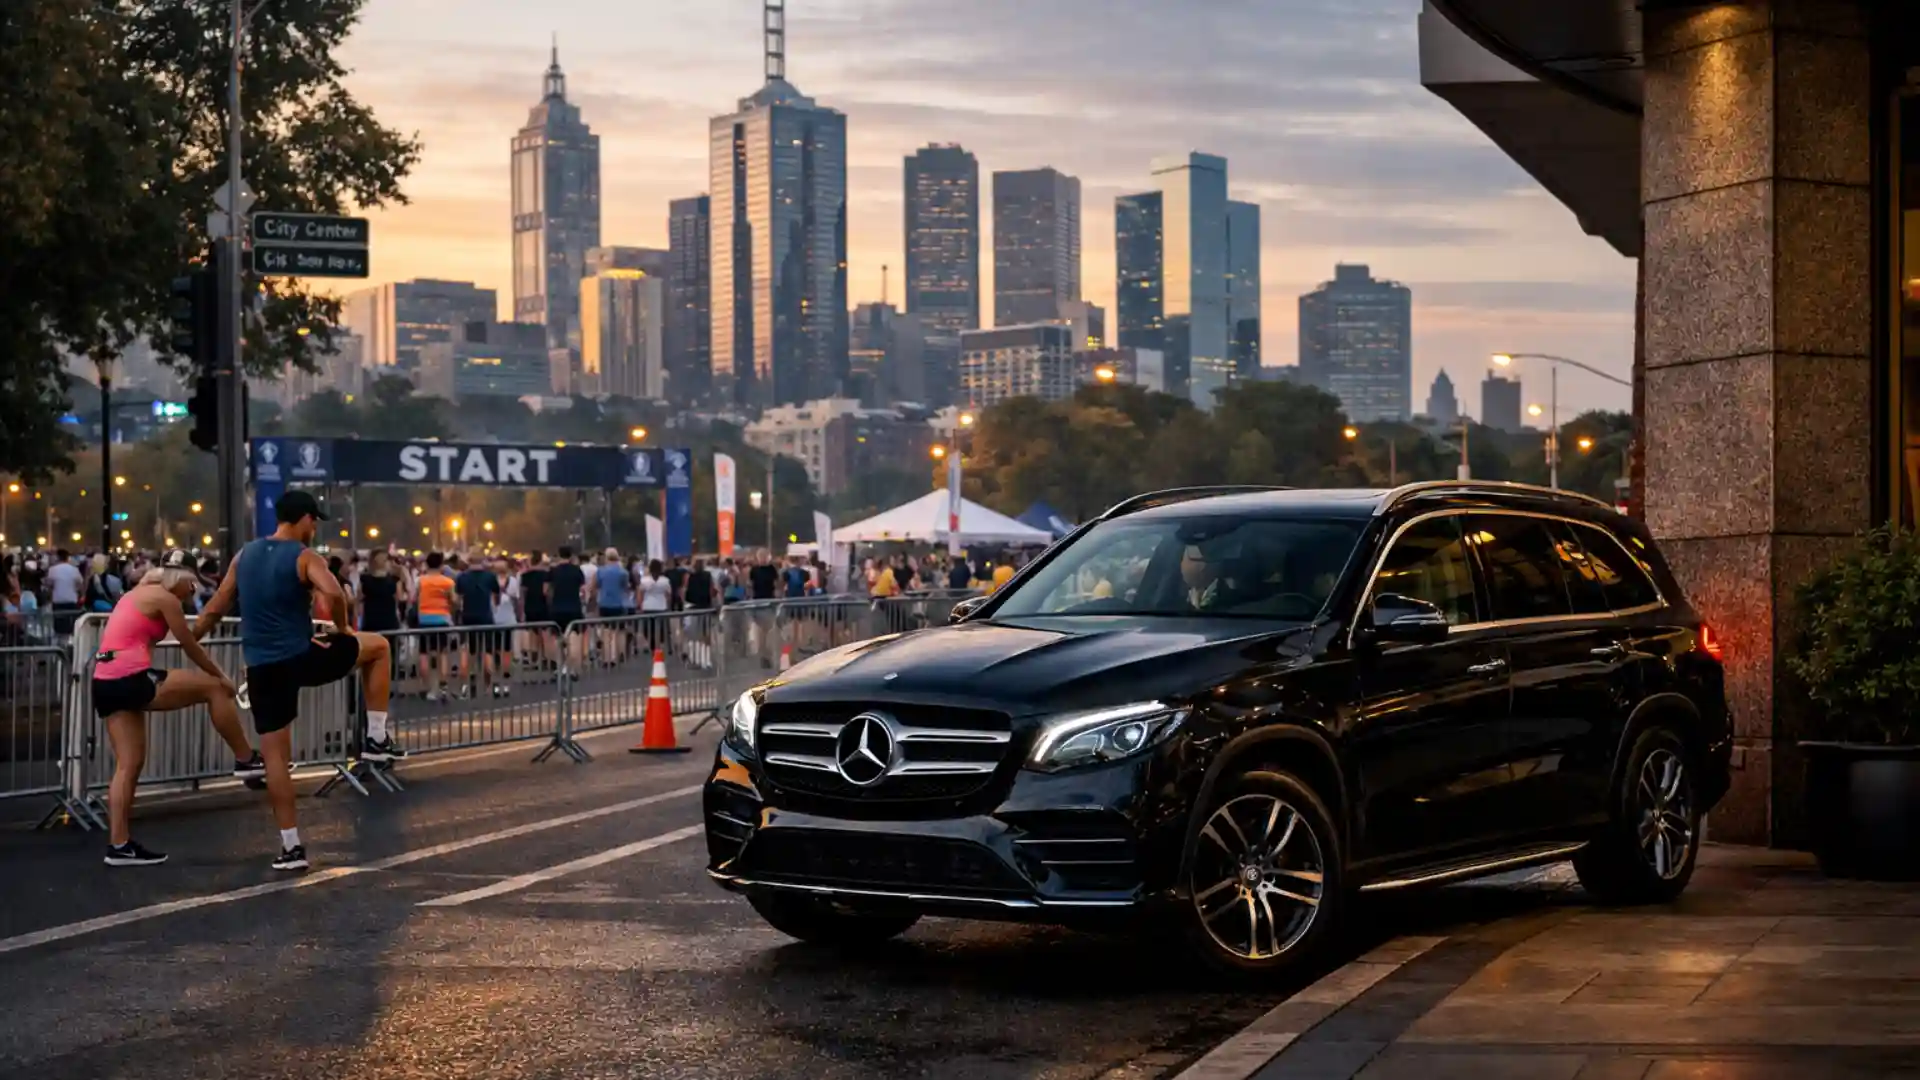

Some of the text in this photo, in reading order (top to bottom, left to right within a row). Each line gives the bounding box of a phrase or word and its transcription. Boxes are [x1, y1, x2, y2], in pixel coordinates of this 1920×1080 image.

[264, 219, 358, 240] City Center
[399, 445, 557, 484] START
